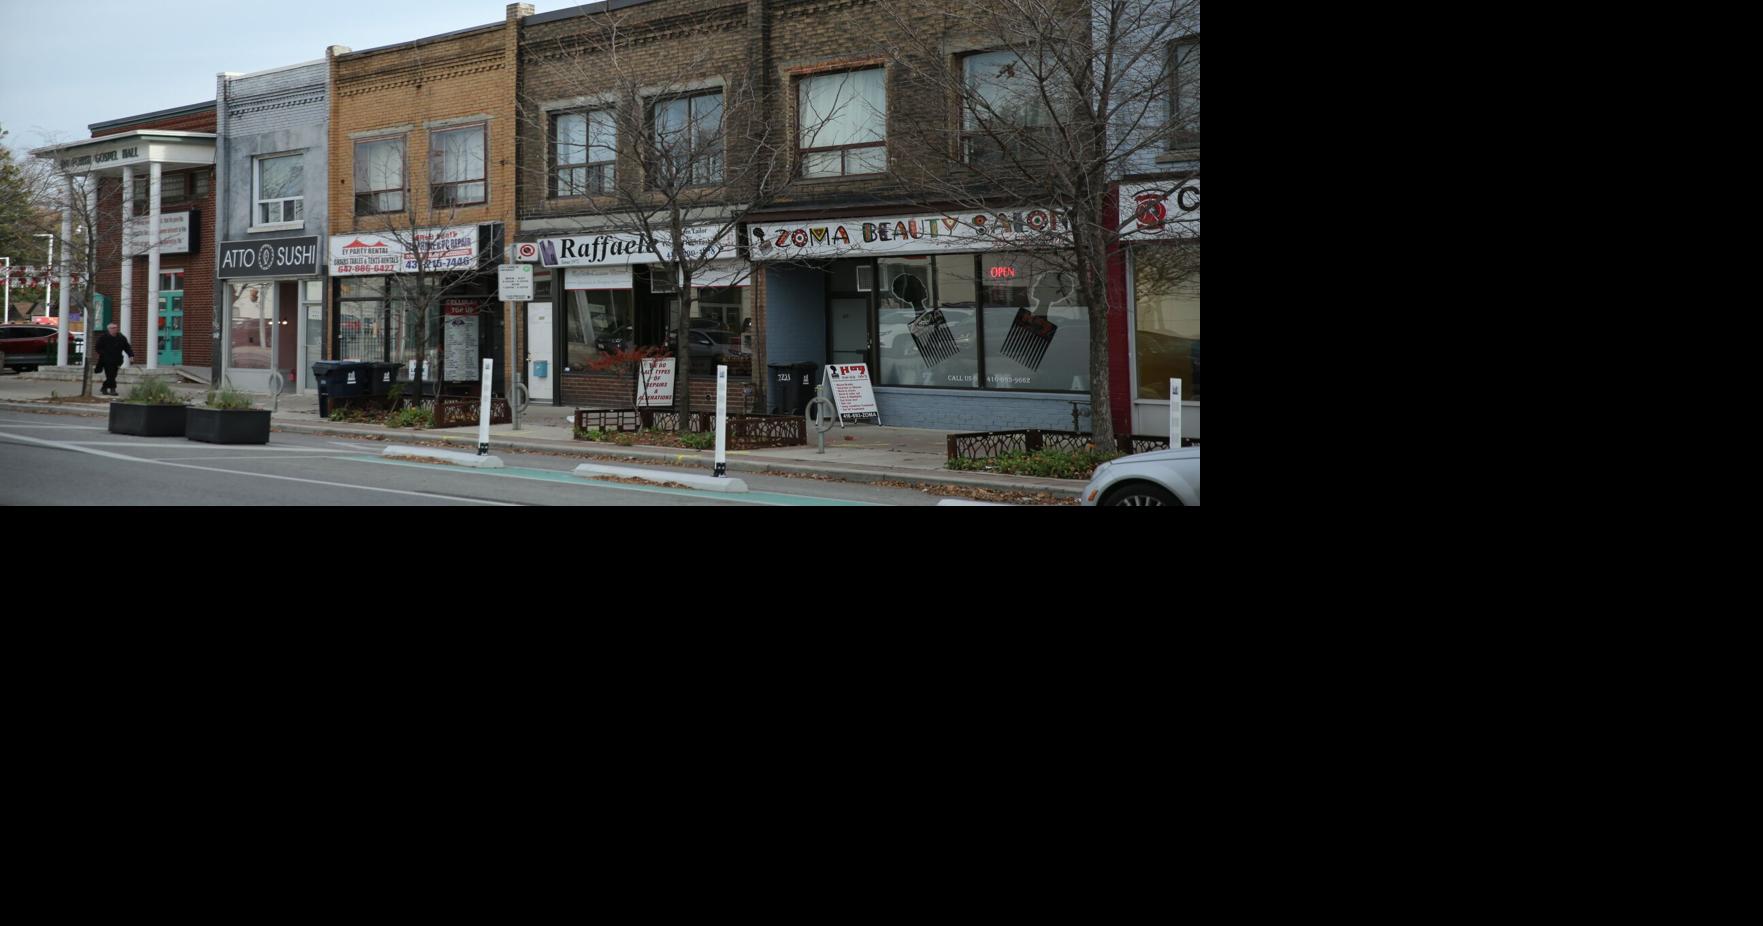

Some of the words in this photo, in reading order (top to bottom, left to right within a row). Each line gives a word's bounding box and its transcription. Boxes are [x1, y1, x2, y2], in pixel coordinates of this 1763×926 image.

[95, 150, 118, 163] GOSPEL
[122, 146, 139, 158] HALL
[774, 225, 850, 248] ZOMA
[862, 216, 959, 243] BEAUTY
[222, 248, 255, 268] ATTO
[277, 244, 316, 266] SUSHI
[368, 247, 388, 255] RENTAL
[350, 257, 364, 265] TABLES
[368, 256, 380, 264] TENTS
[381, 256, 399, 264] RENTALS
[405, 256, 470, 269] 43-215-7446
[990, 266, 1016, 279] OPEN
